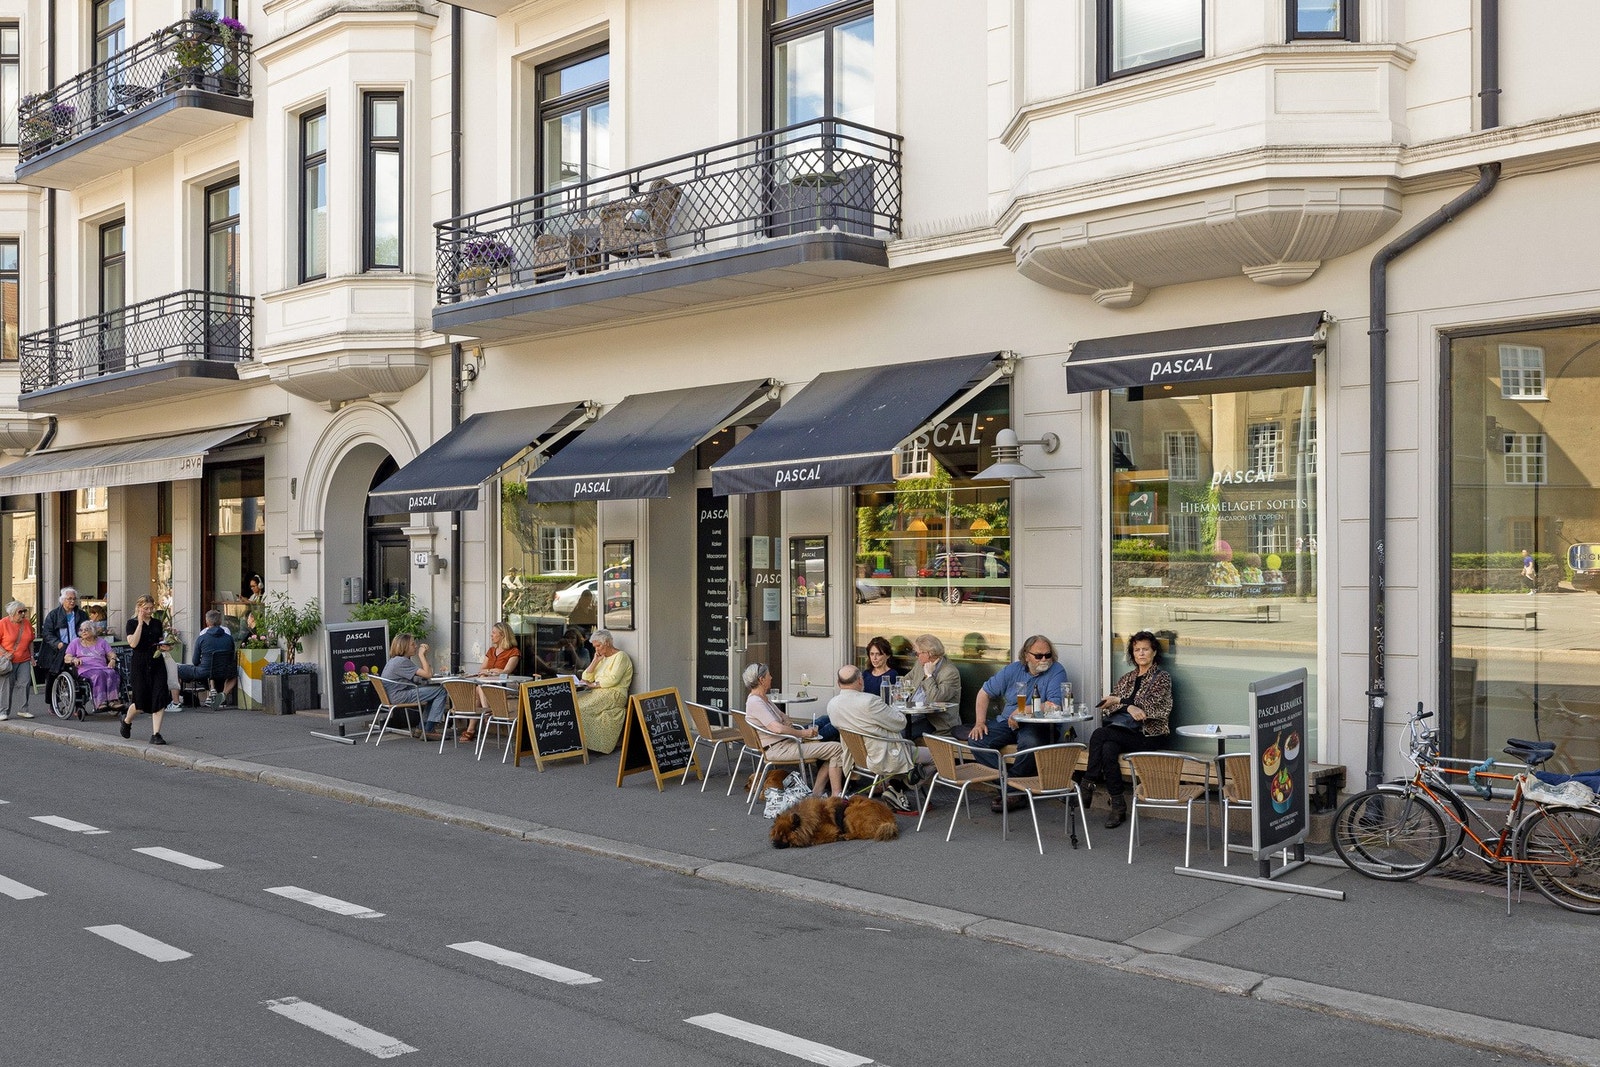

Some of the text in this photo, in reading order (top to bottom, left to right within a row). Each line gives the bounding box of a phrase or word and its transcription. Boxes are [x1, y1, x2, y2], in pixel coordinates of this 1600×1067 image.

[1150, 354, 1213, 381] PASCAL
[181, 457, 202, 470] JAVA
[773, 464, 821, 487] PASCAL
[574, 478, 611, 497] PASCAL
[408, 493, 437, 510] PASCAL
